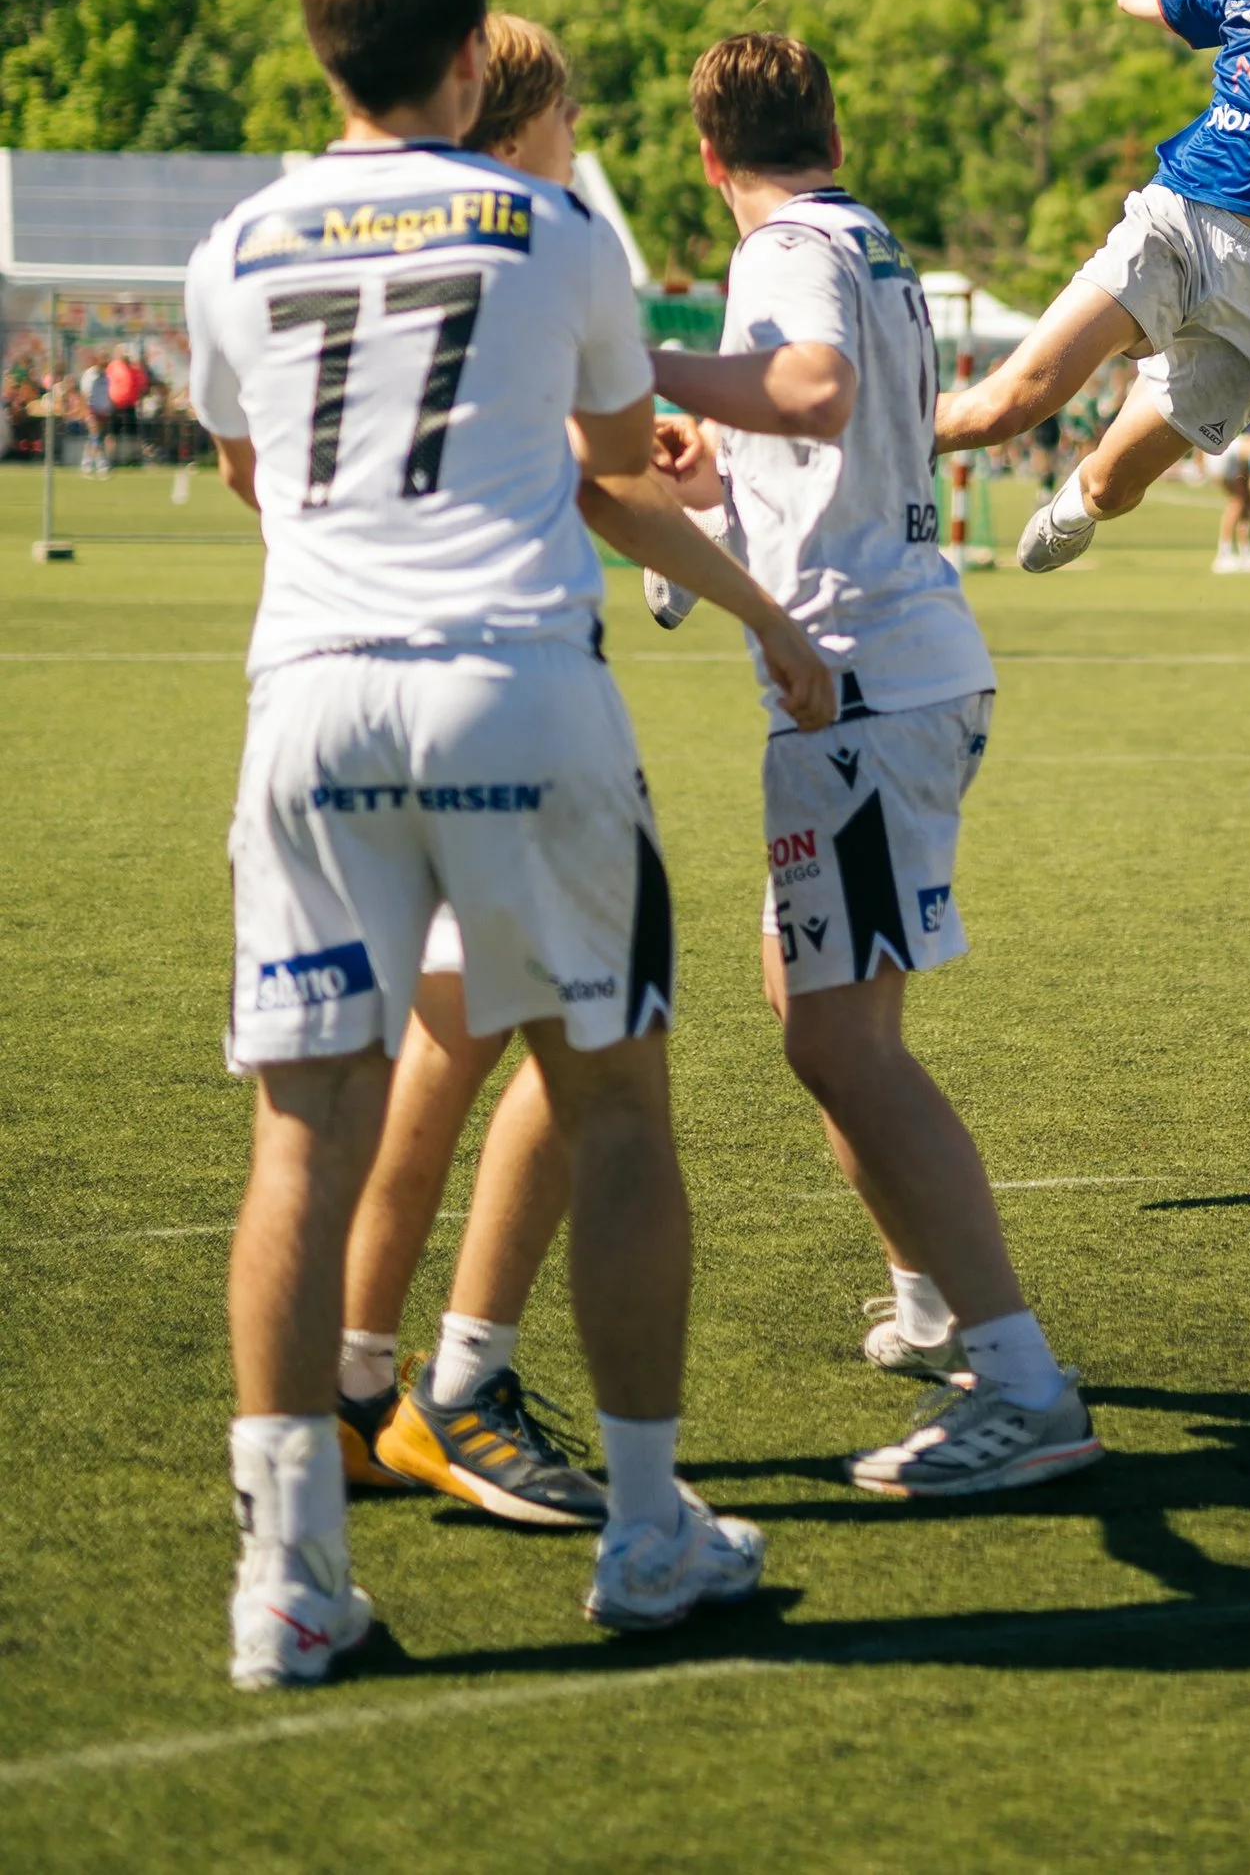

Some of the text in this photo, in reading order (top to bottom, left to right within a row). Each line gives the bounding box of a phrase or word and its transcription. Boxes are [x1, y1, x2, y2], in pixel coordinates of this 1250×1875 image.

[322, 190, 529, 253] MegaFlis
[267, 271, 483, 510] 77
[1199, 425, 1223, 446] SELECT
[768, 829, 817, 869] ON
